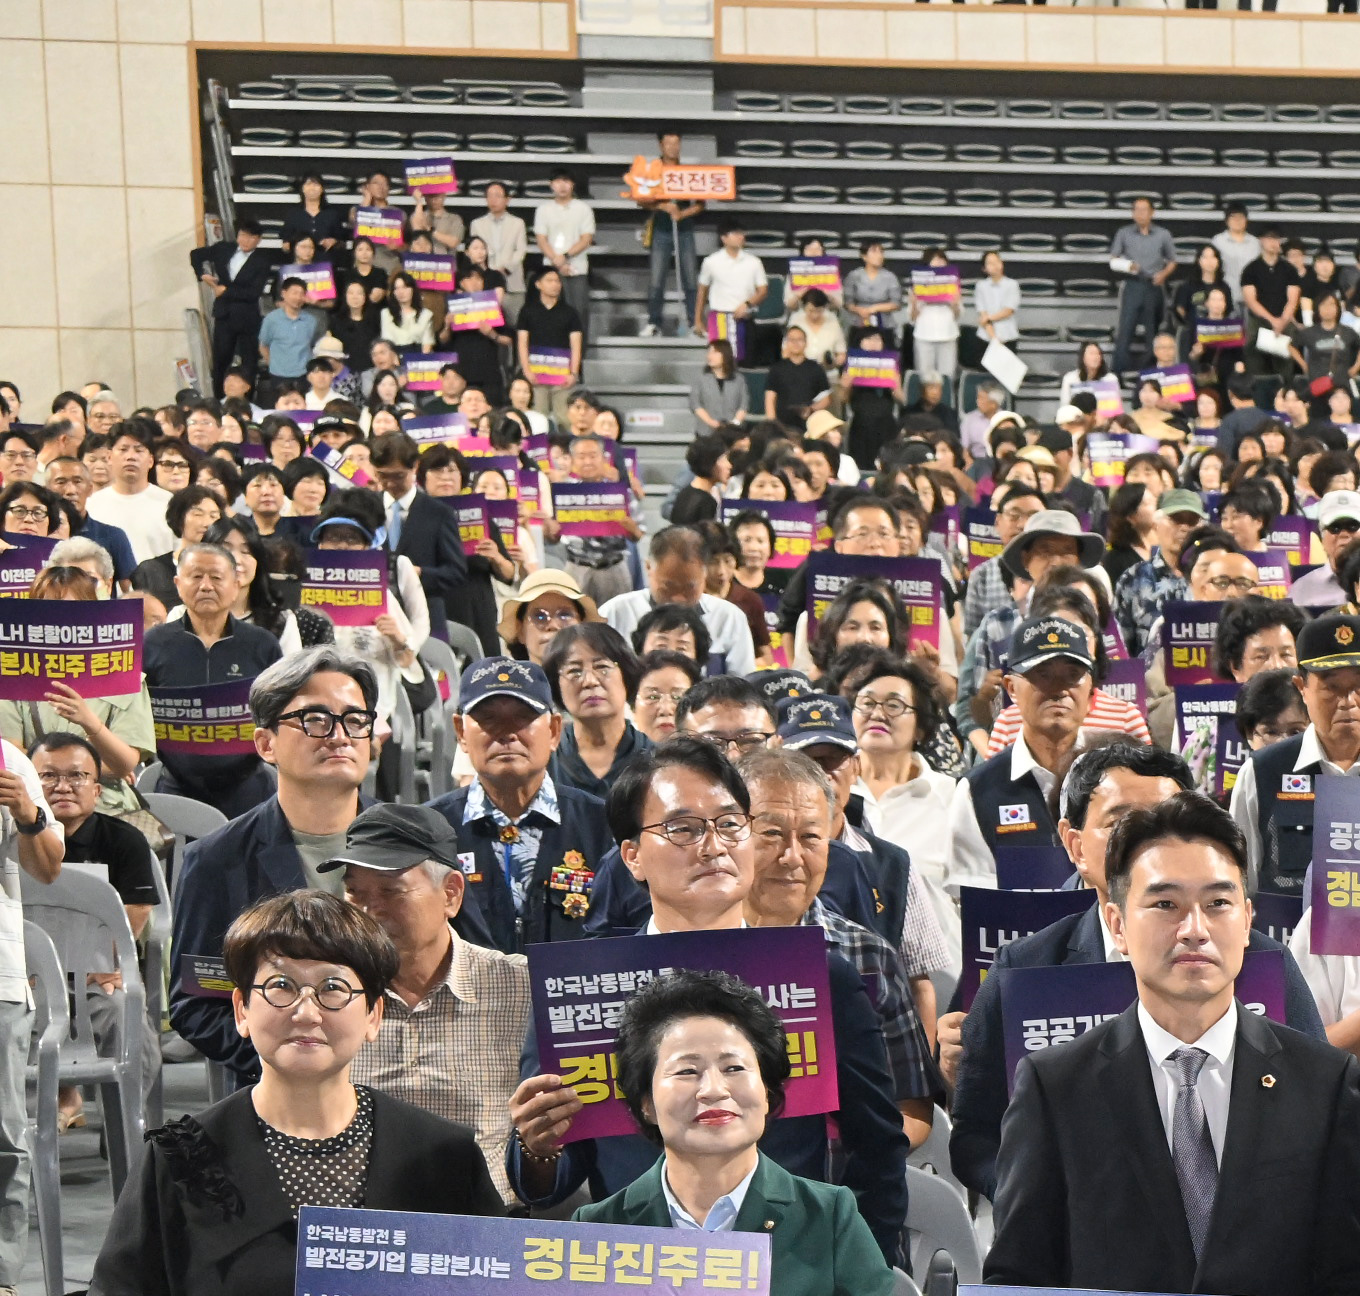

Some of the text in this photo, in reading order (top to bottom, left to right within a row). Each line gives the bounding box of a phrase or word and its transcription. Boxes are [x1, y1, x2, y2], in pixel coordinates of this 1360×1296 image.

[666, 172, 727, 193] 천전동
[0, 624, 133, 644] LH 분할이전 반대!
[1, 651, 134, 678] 본사 진주 존치!
[545, 969, 653, 998] 한국남동발전
[306, 1224, 407, 1245] 한국남동발전 등
[305, 1237, 759, 1289] 발전공기업 통합본사는 경남진주로!
